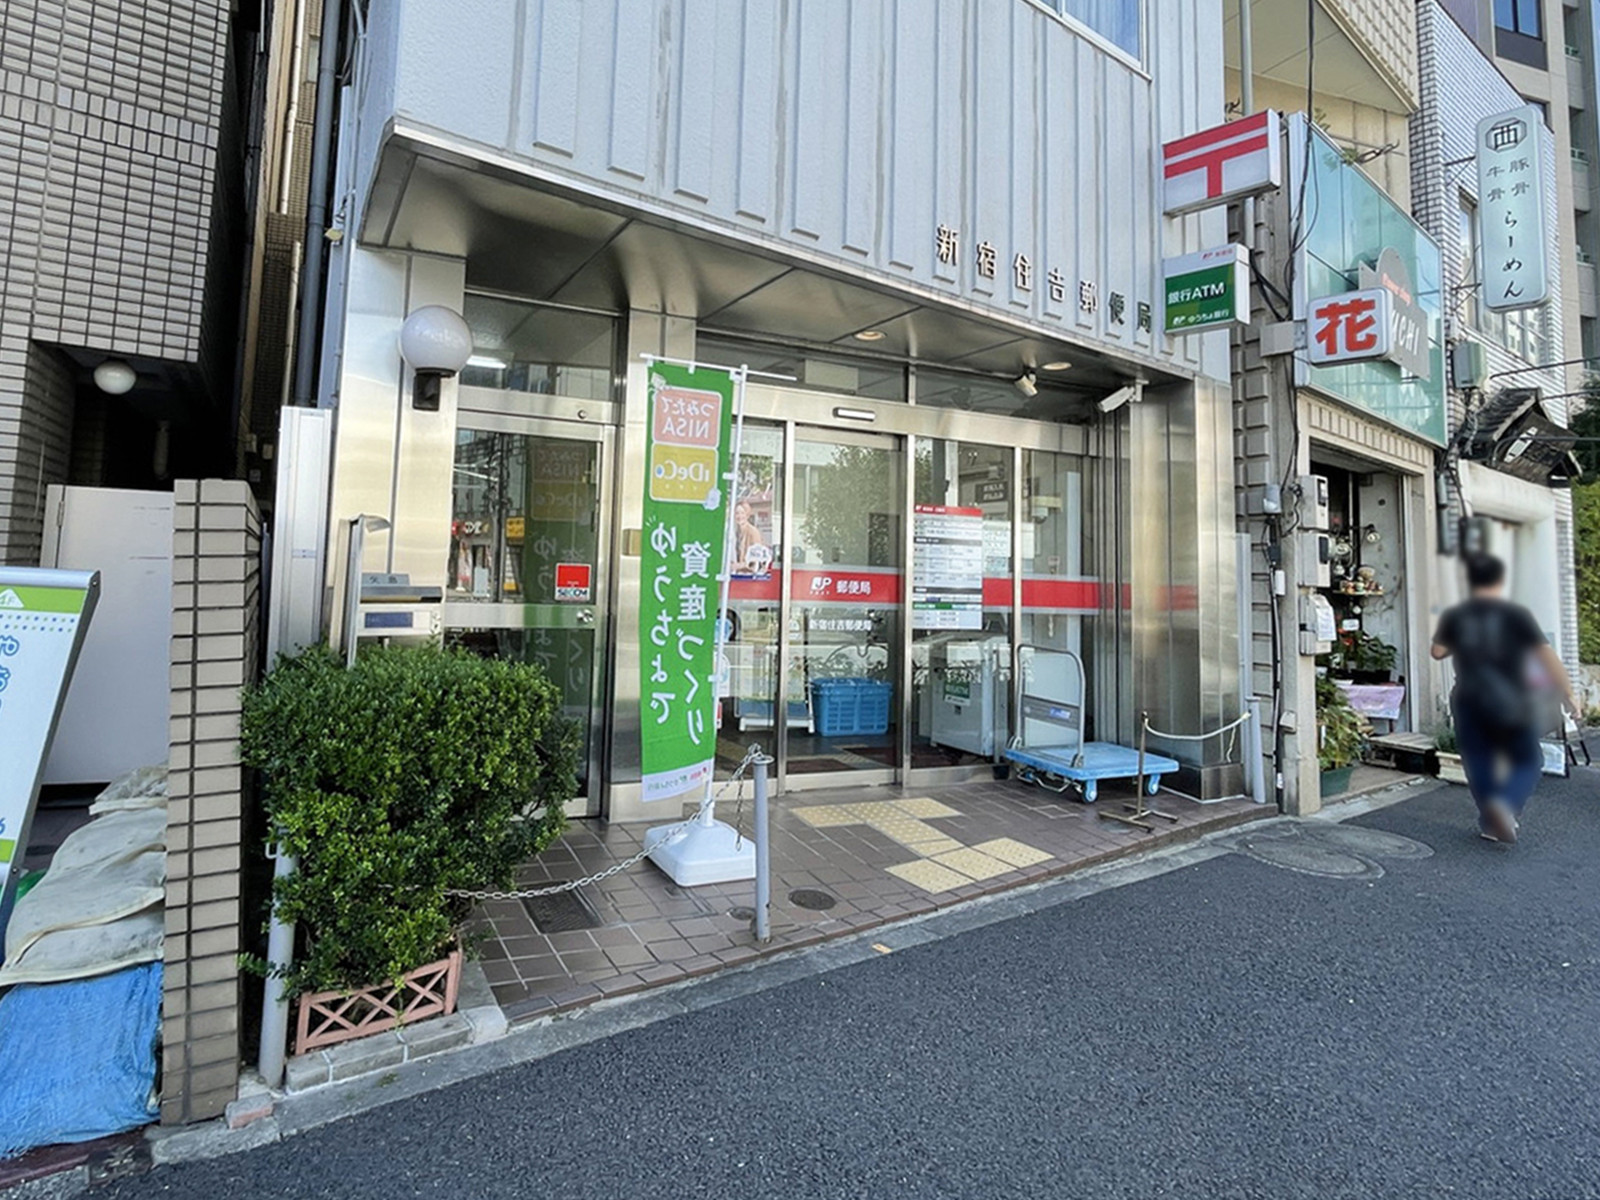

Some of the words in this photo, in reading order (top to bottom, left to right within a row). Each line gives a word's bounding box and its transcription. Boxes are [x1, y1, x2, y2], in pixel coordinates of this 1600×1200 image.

[1486, 165, 1506, 203] 牛骨
[1509, 156, 1530, 198] 豚骨
[1502, 211, 1525, 299] らーめん
[935, 224, 1152, 334] 新宿住吉郵便局
[1168, 282, 1225, 305] 銀行ATM
[1315, 298, 1378, 356] 花
[837, 580, 871, 595] 郵便局
